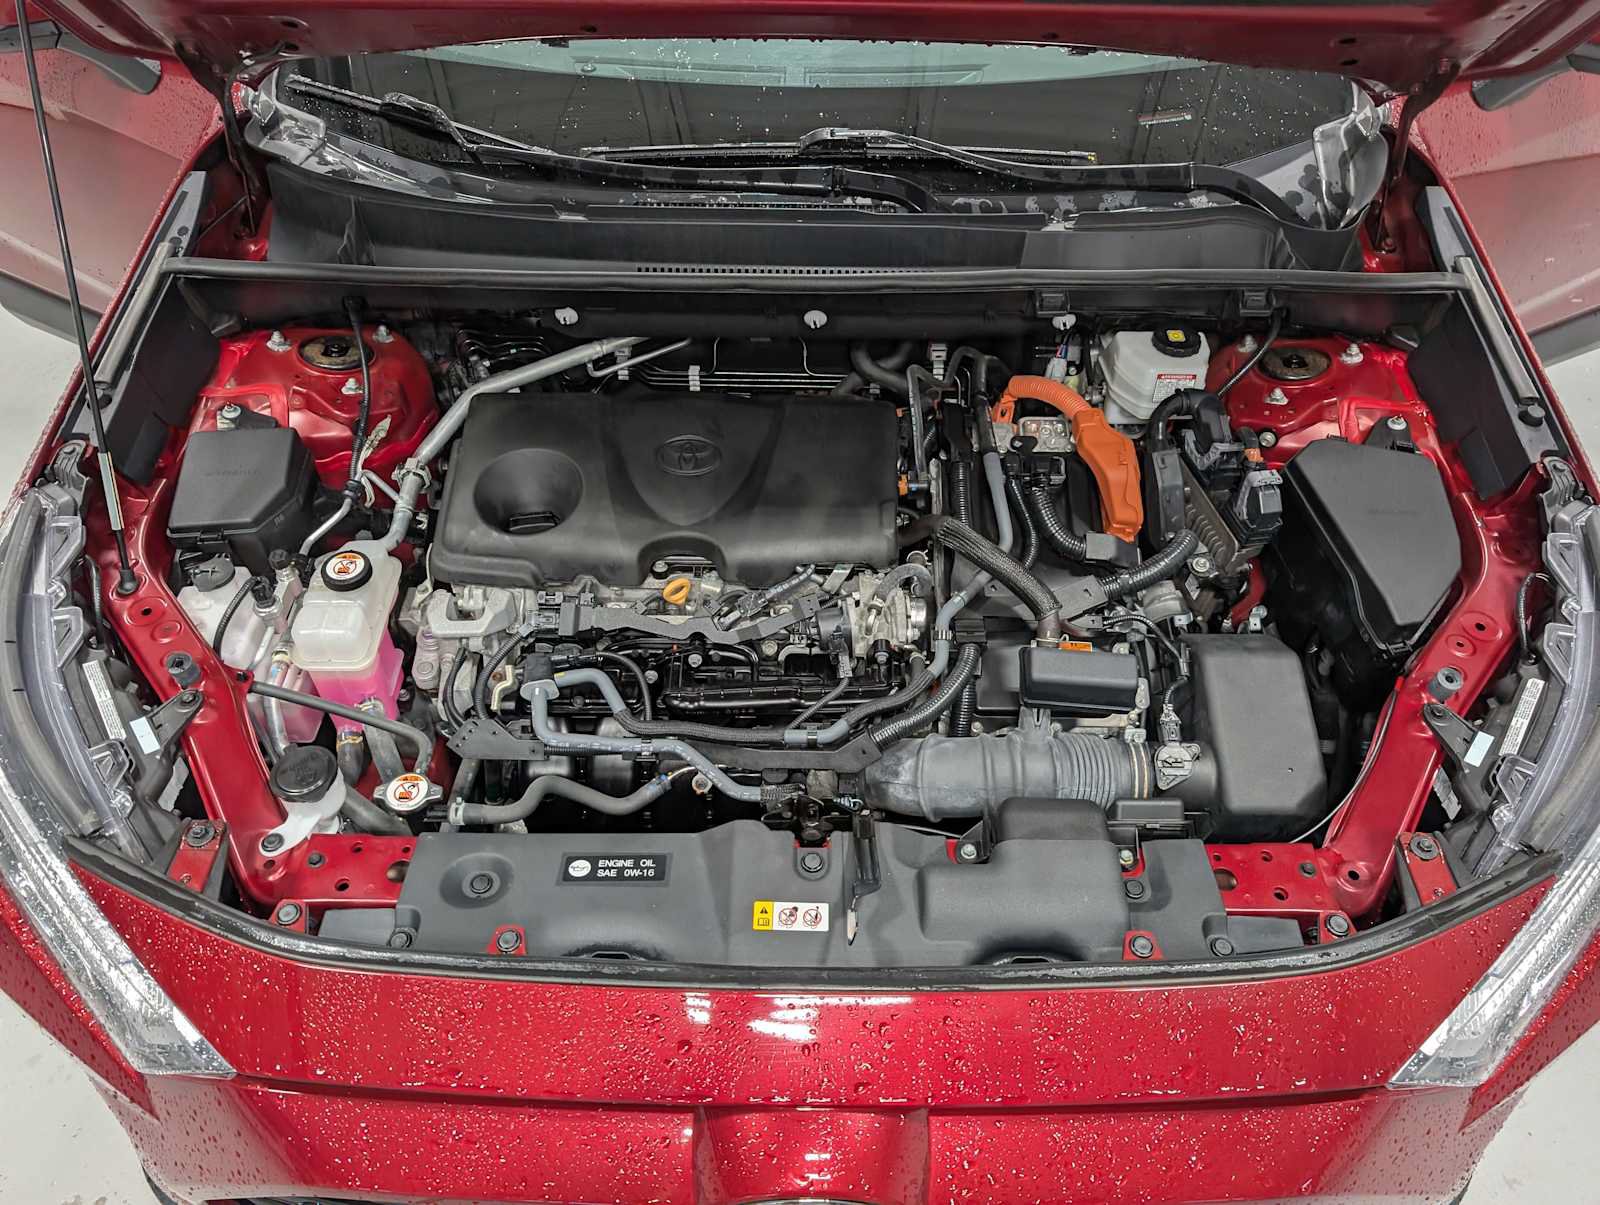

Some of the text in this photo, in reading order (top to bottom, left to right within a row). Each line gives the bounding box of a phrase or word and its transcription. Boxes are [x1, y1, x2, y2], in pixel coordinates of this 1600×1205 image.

[598, 859, 656, 868] ENGINE OIL
[596, 868, 656, 877] SAE 0W-16
